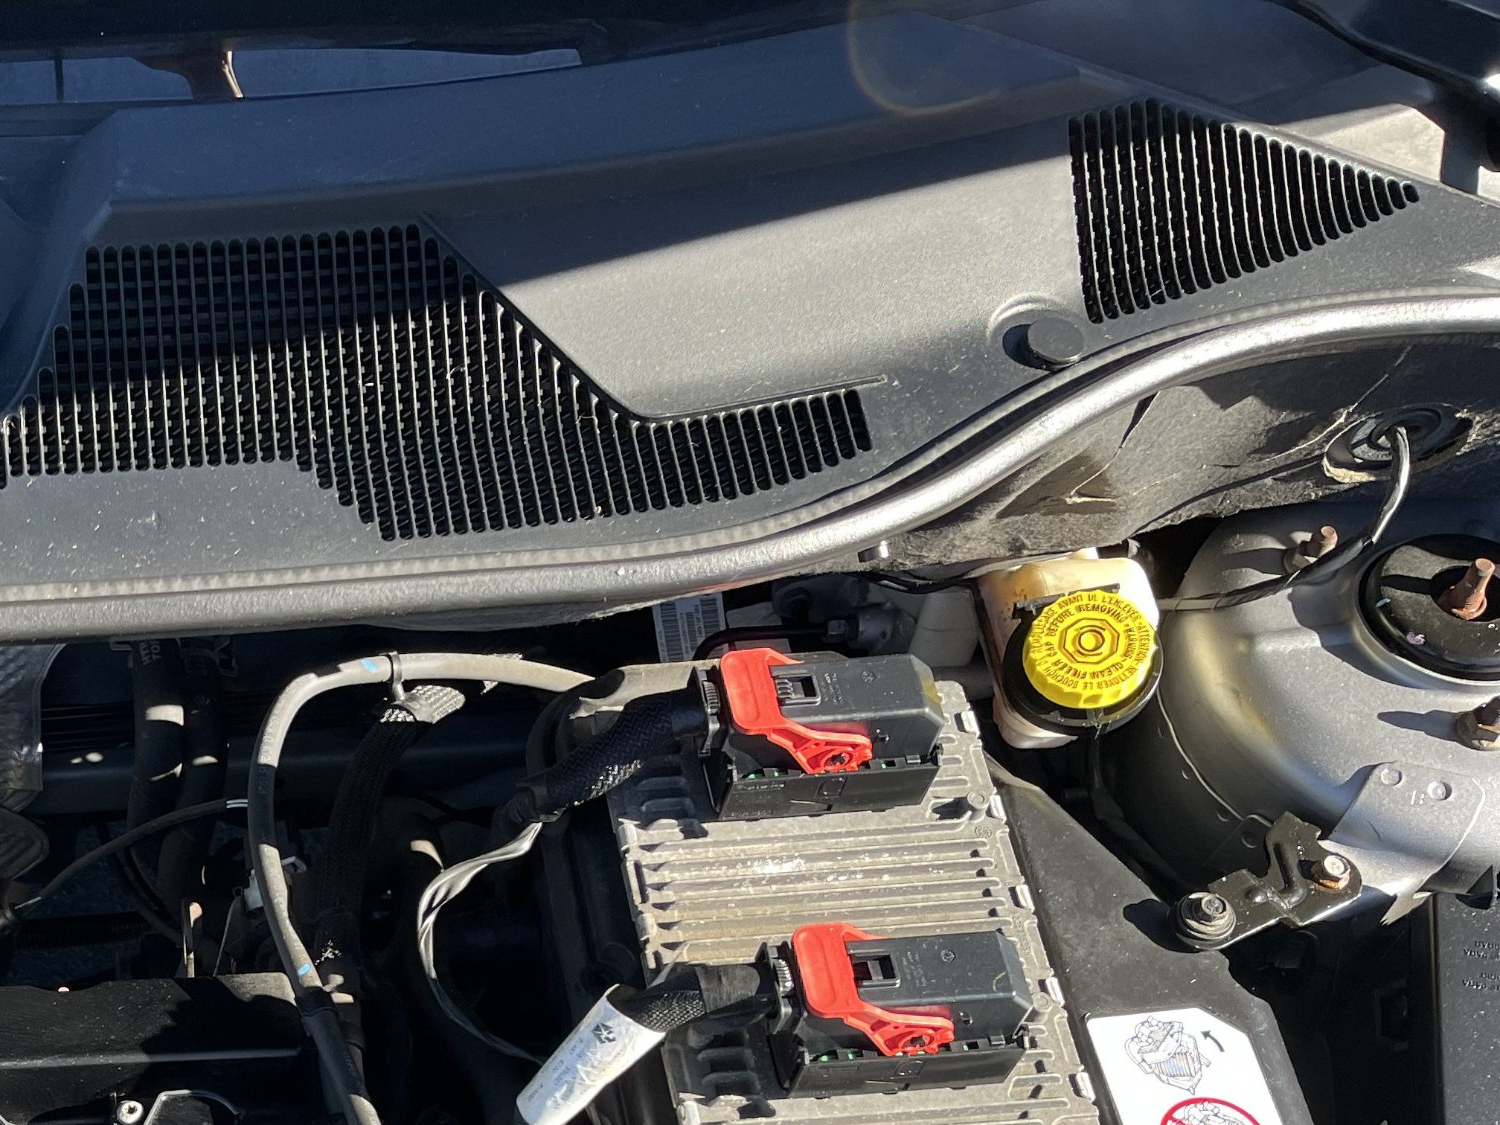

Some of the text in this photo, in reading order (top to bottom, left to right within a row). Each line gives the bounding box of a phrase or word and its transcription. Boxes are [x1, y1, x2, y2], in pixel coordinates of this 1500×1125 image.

[1047, 608, 1076, 637] BEFORE
[1076, 603, 1126, 624] REMOVING
[1043, 665, 1079, 689] BOUCHON
[1053, 659, 1088, 679] FILLER
[1090, 661, 1125, 679] CLEAN
